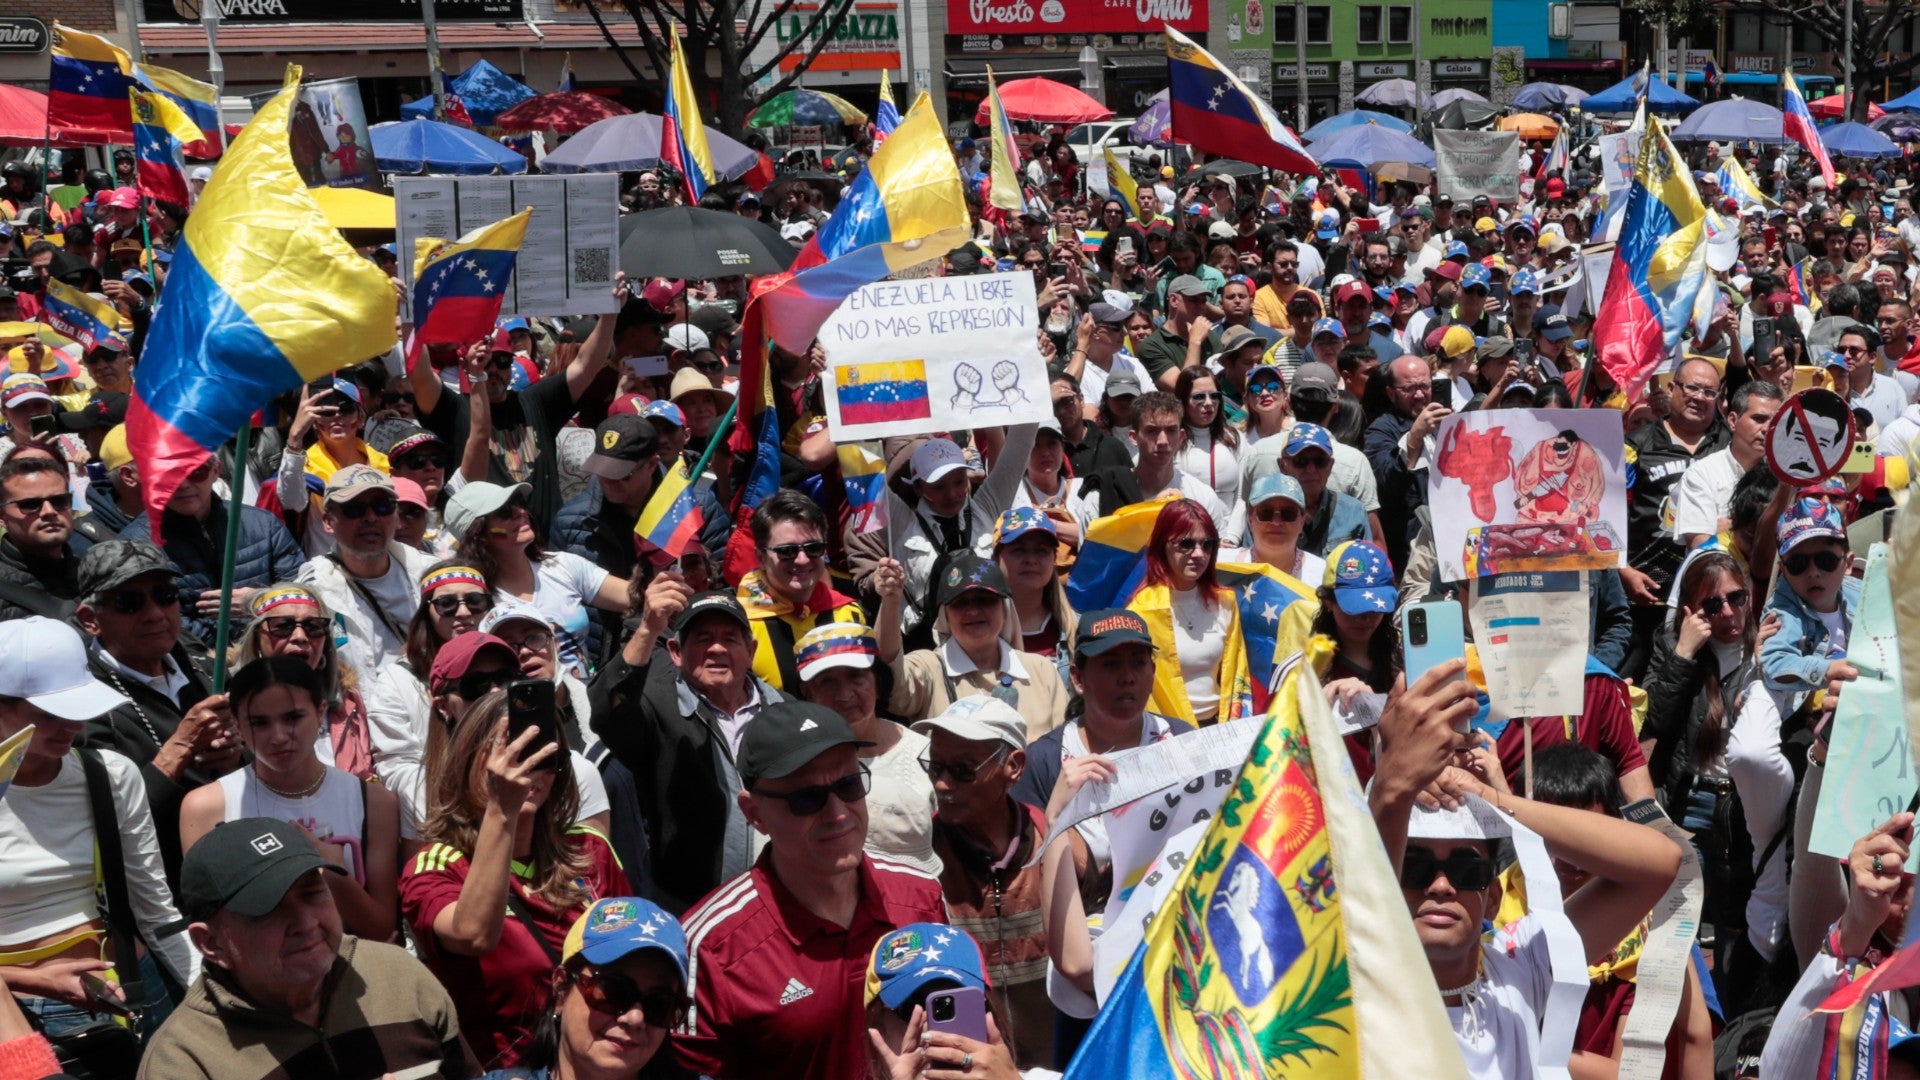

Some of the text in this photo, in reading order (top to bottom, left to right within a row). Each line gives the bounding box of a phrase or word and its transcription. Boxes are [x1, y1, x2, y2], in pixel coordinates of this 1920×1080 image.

[214, 0, 289, 19] VARRA
[969, 0, 1035, 24] Presto
[1136, 0, 1193, 23] Oma
[1280, 67, 1327, 76] Paslería
[1373, 66, 1395, 75] Café
[1446, 65, 1472, 73] Gelato
[1734, 56, 1775, 72] MARKET
[850, 279, 1014, 311] ENEZUELA LIBRE
[837, 319, 870, 342] NO
[874, 315, 922, 339] MAS
[1090, 614, 1145, 637] CARACAS
[780, 987, 815, 1005] adidas
